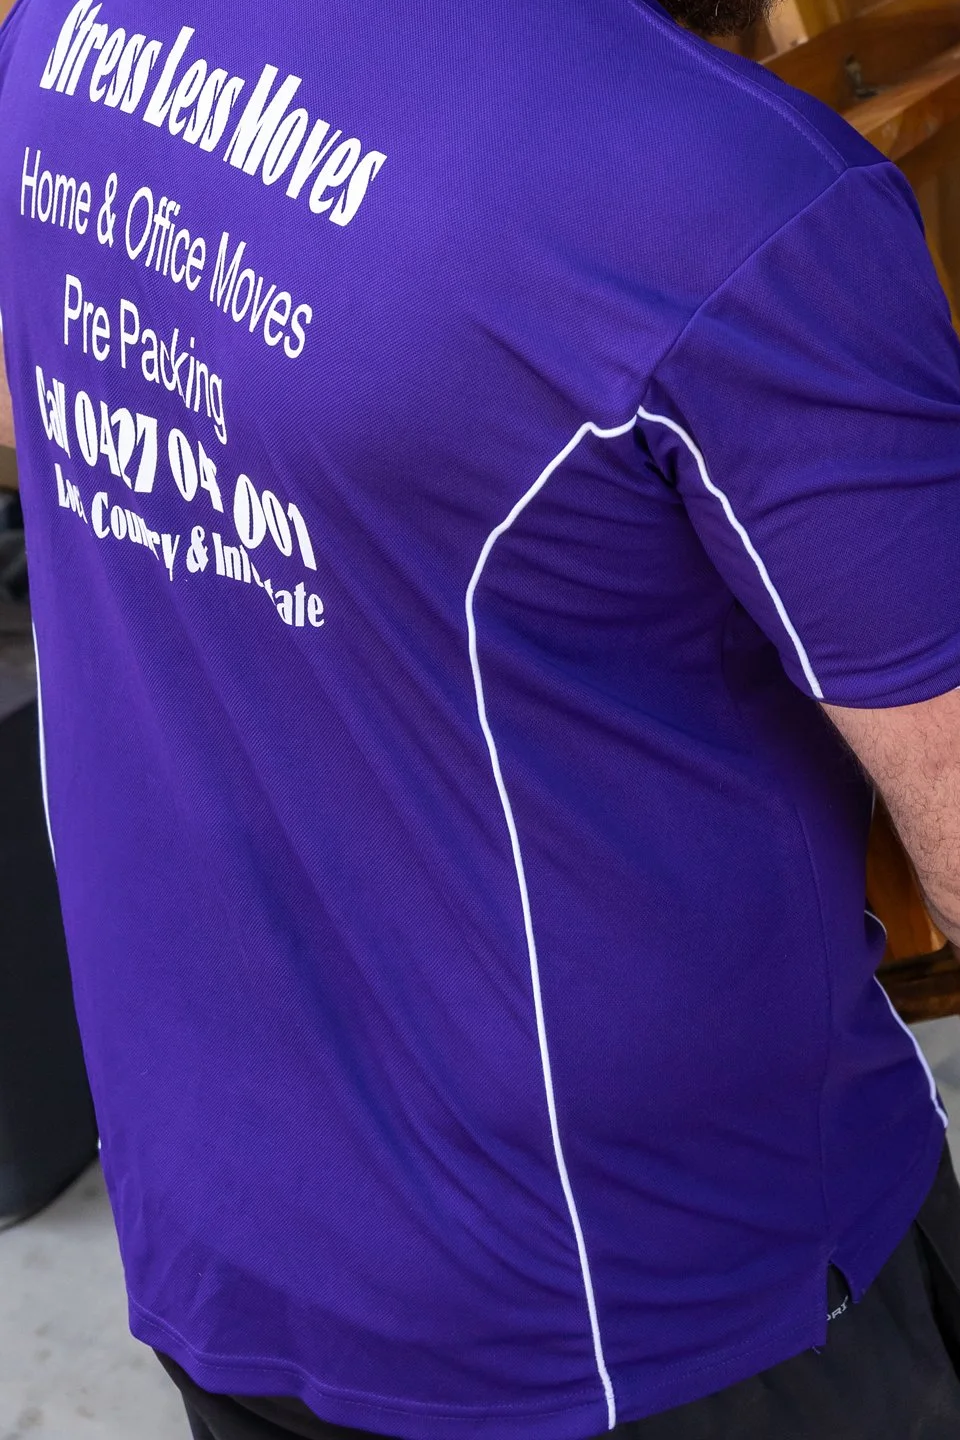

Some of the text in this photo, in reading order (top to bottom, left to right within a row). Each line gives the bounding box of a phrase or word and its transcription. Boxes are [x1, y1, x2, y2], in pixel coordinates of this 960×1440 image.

[142, 25, 246, 153] Less
[222, 63, 388, 227] Moves
[20, 146, 313, 359] Home & Office Moves
[63, 273, 228, 445] Pre Packing
[74, 390, 158, 494] 0427
[167, 427, 224, 514] 04
[233, 473, 317, 571] 001
[185, 525, 209, 574] &
